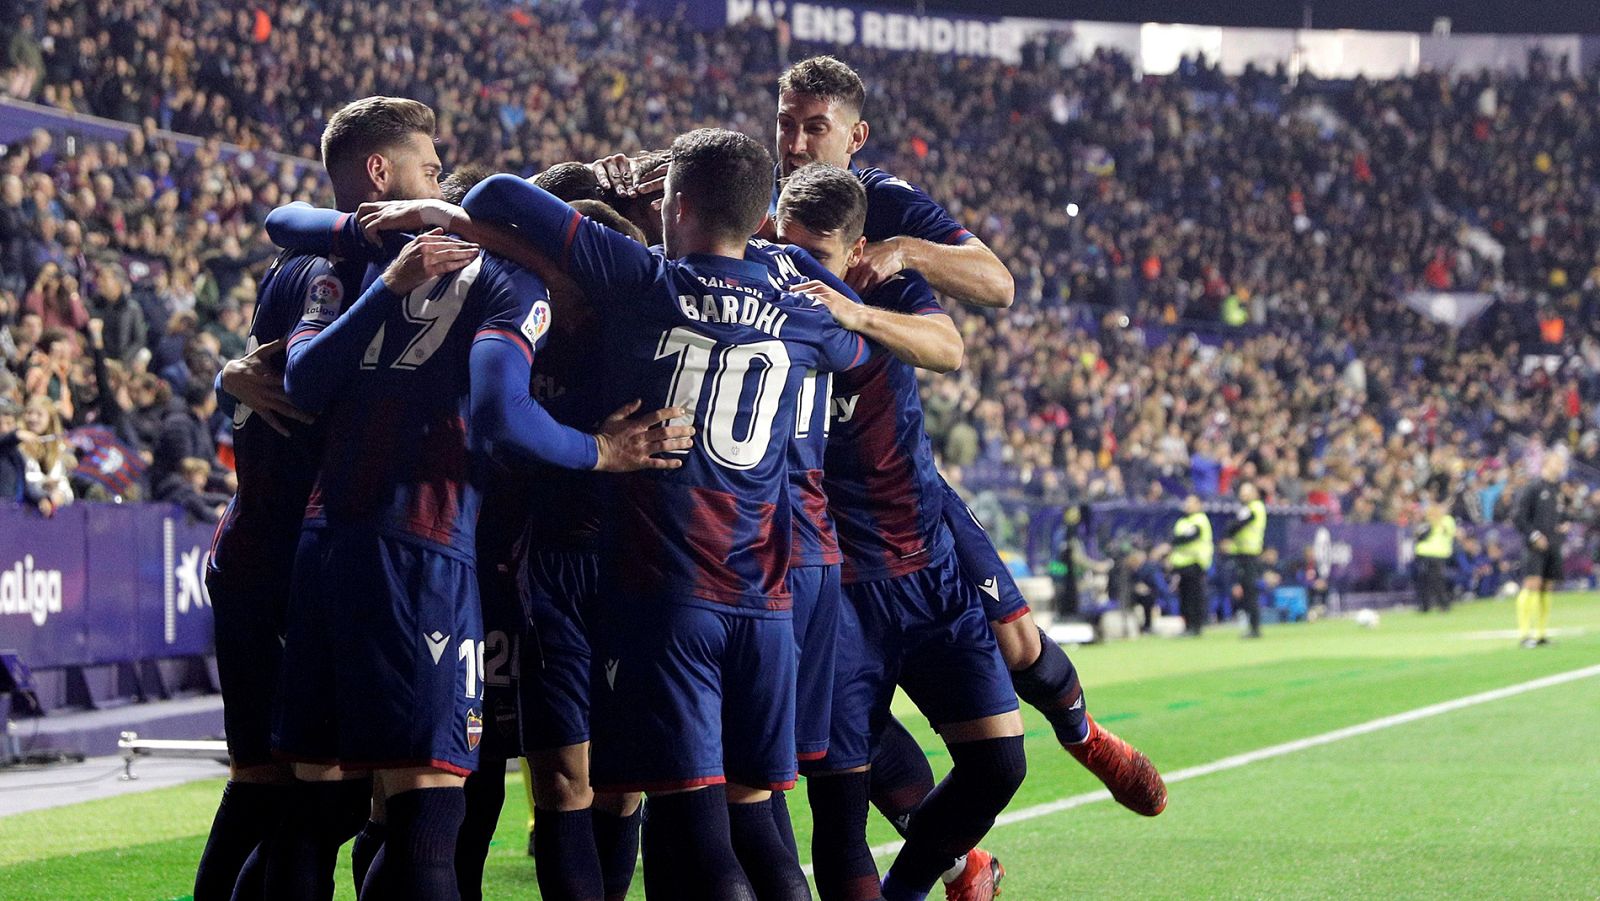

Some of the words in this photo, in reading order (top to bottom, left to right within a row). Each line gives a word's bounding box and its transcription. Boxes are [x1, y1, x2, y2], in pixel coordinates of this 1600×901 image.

[791, 2, 855, 46] ENS
[678, 295, 788, 339] BARDHI
[654, 325, 791, 471] 10
[0, 554, 62, 626] aLiga
